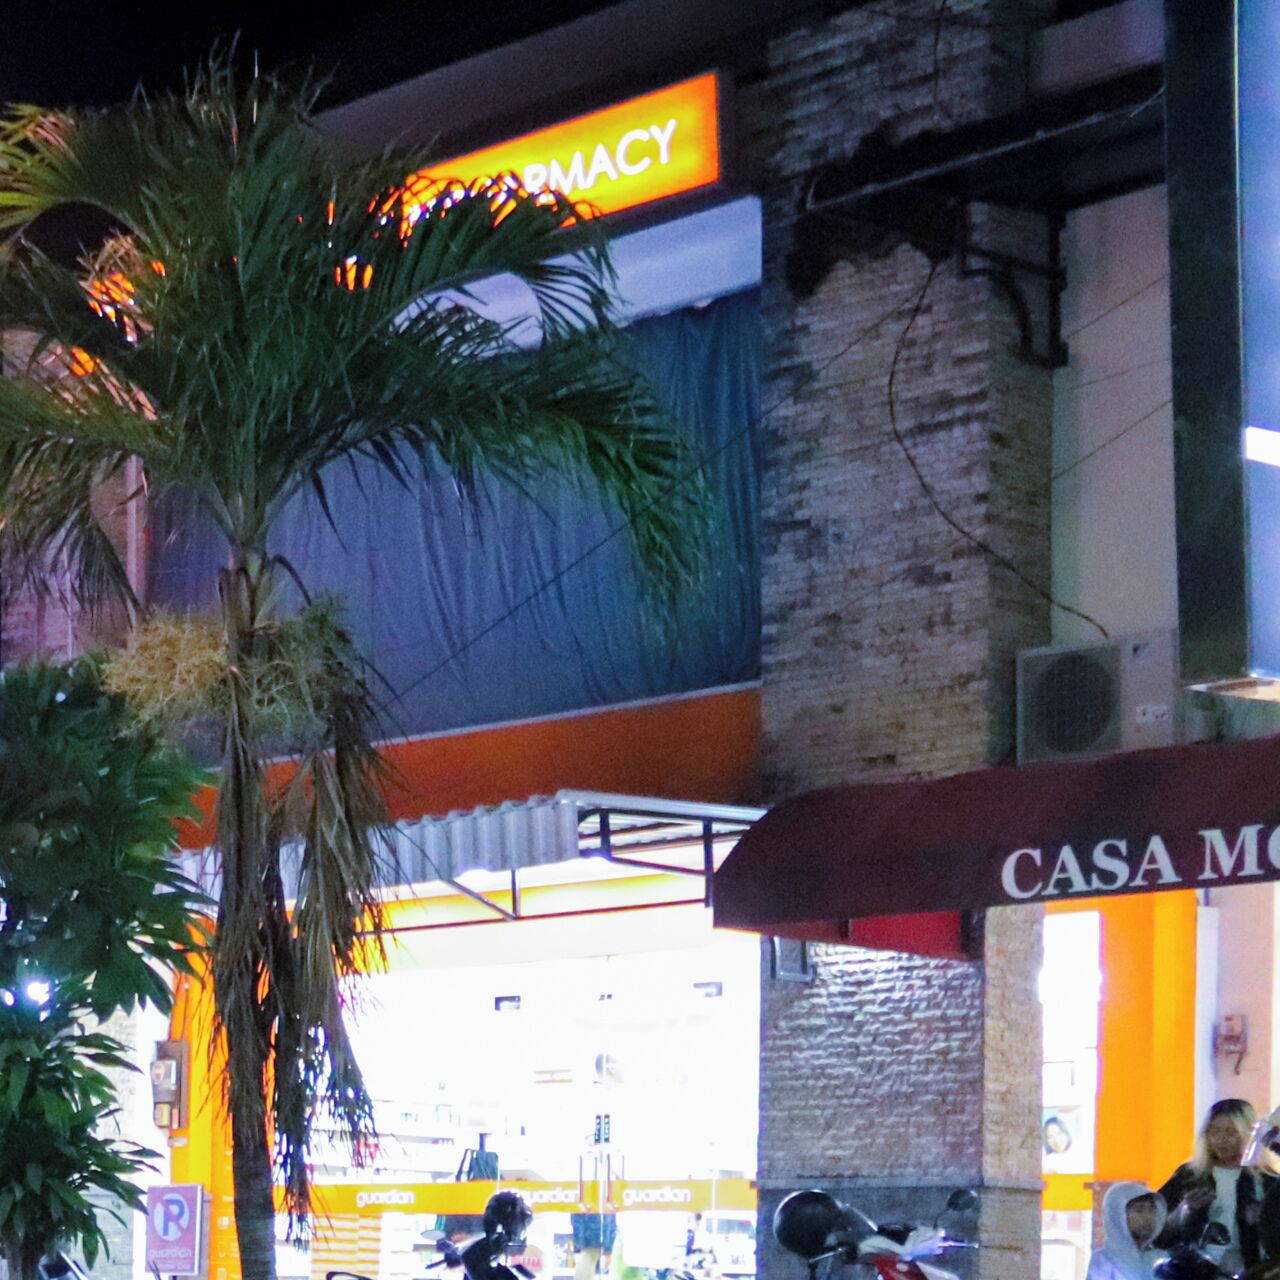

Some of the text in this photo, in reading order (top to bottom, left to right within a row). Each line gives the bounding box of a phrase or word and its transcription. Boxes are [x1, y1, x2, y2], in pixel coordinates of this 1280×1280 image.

[1000, 833, 1183, 900] CASA
[355, 1185, 692, 1208] guardian uardian guardian
